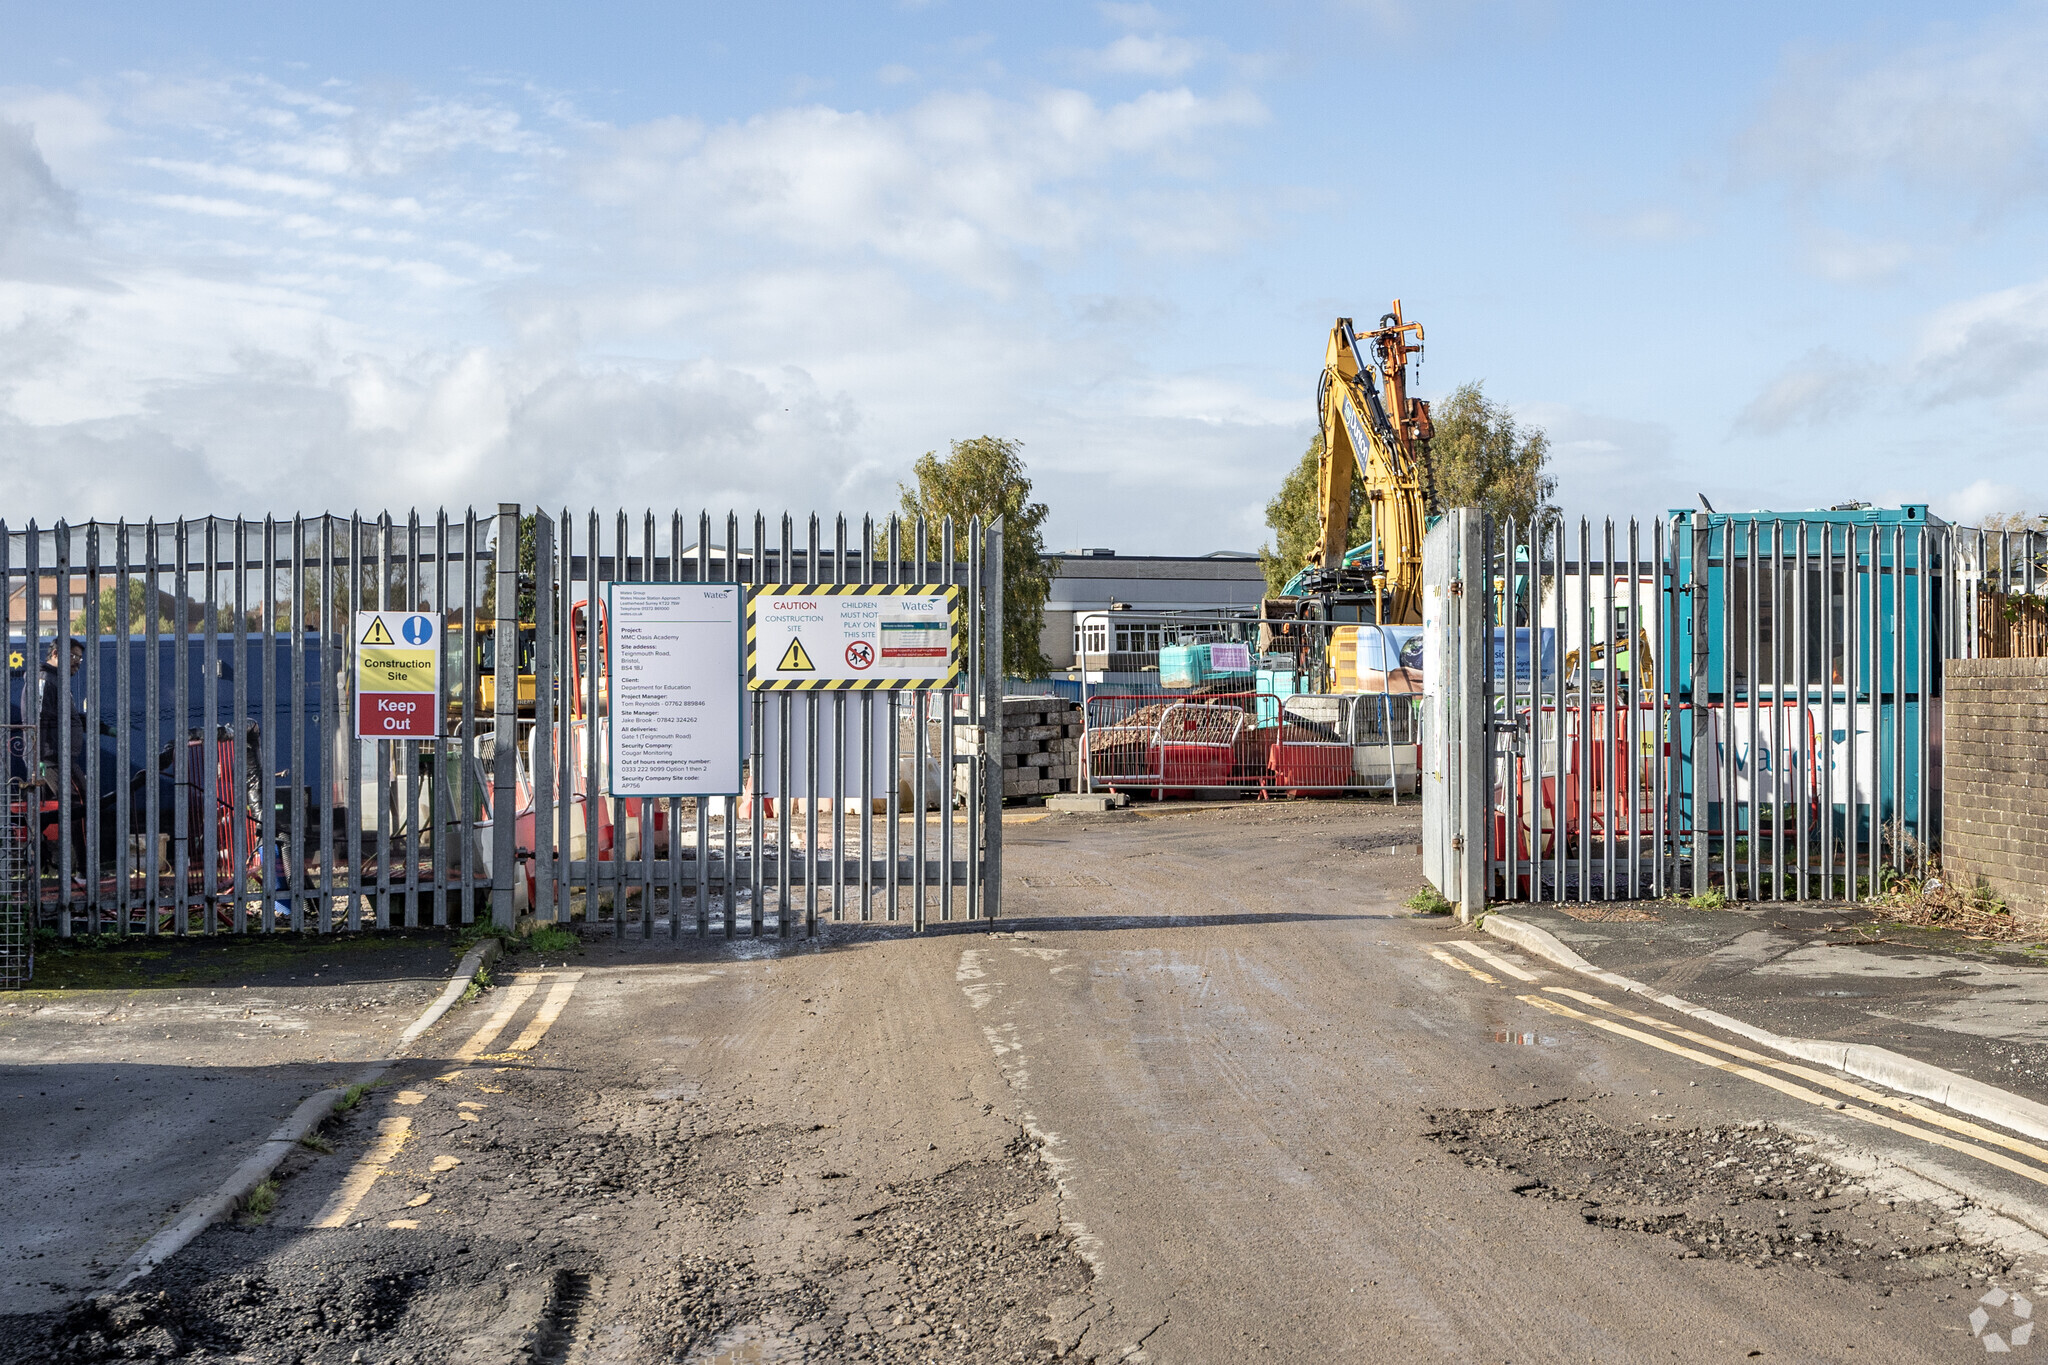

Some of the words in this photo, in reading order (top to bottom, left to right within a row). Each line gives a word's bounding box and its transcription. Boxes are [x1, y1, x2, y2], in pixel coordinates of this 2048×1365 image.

[1350, 410, 1369, 462] Dunton
[902, 602, 934, 610] Wates
[364, 659, 431, 668] Construction
[388, 672, 408, 680] Site
[378, 699, 416, 714] Keep
[383, 717, 410, 730] Out
[1716, 742, 1836, 772] Waes
